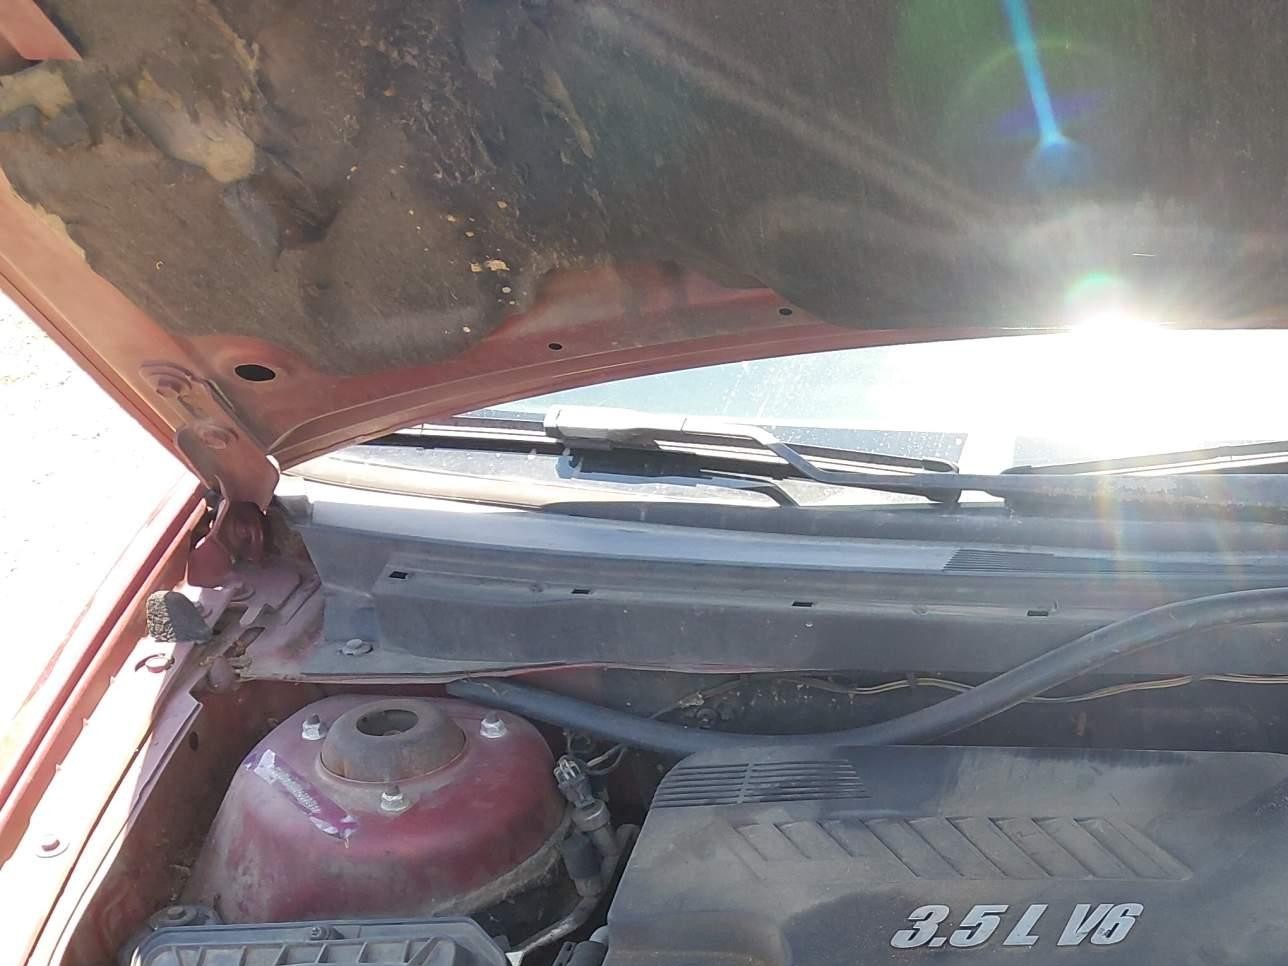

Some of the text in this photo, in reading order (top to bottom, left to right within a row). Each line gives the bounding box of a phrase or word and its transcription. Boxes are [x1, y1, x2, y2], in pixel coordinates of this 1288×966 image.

[889, 902, 1145, 949] 3.5 L V6
